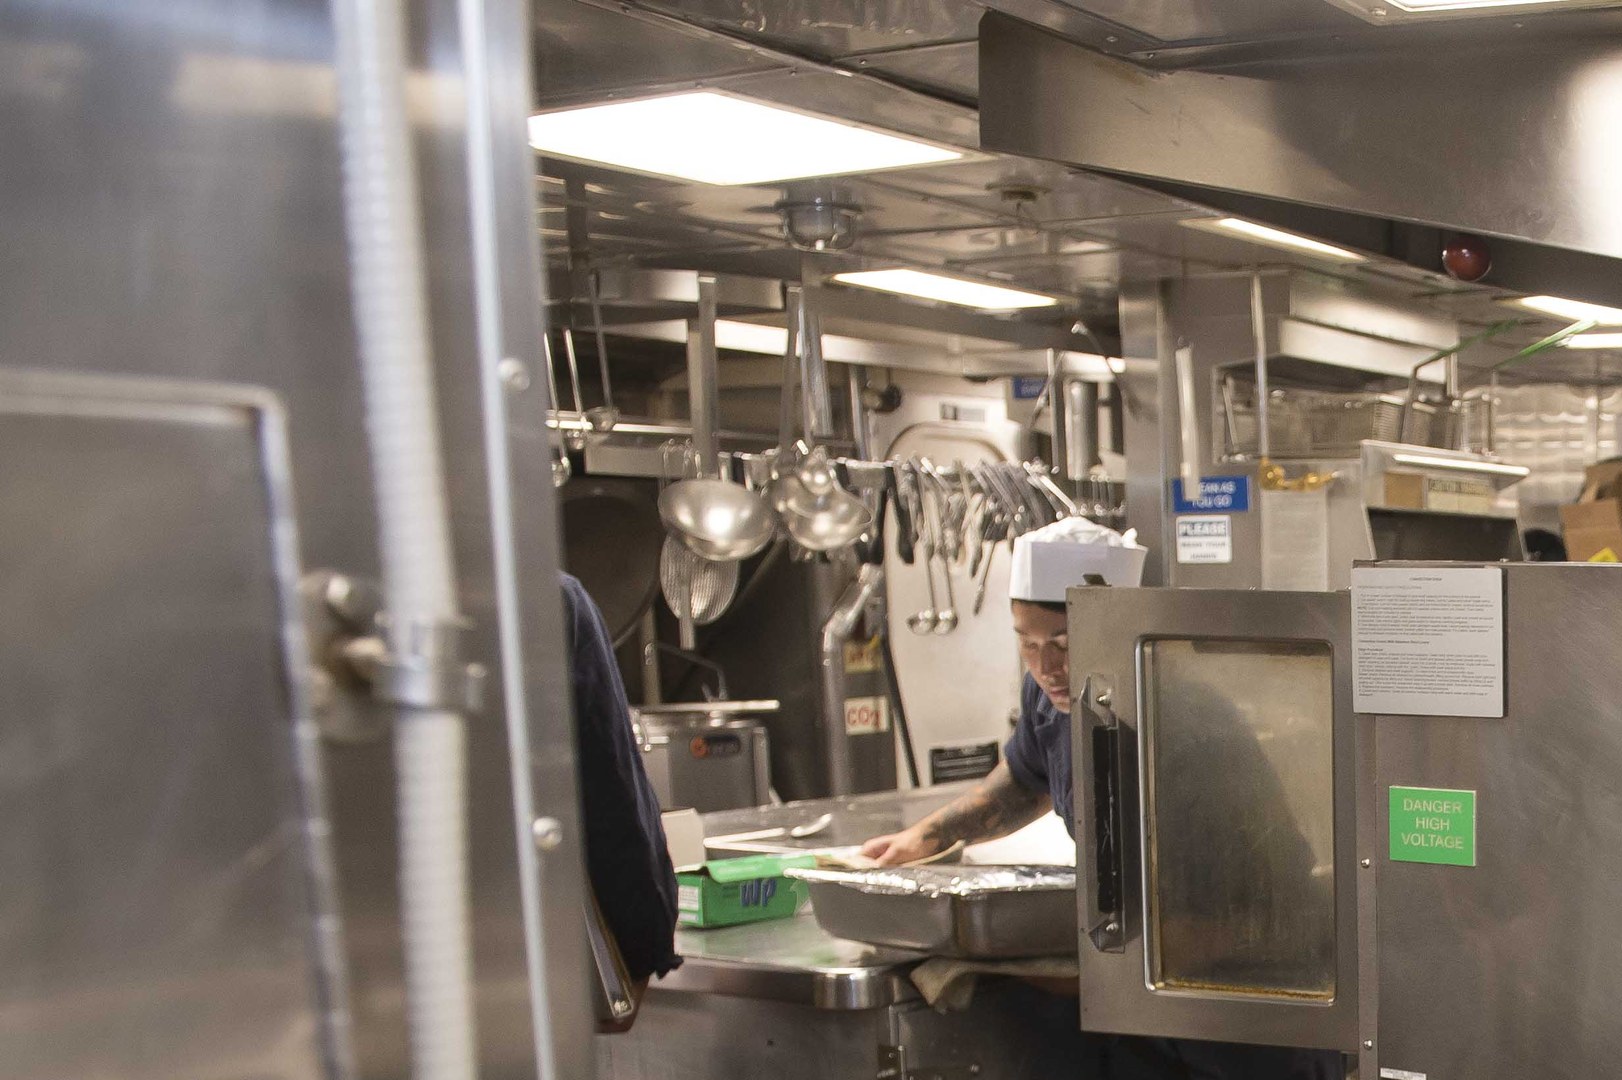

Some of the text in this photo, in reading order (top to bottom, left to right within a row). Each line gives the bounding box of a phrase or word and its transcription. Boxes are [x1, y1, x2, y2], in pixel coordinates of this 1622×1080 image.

[1178, 522, 1226, 536] PLEASE
[1403, 798, 1462, 814] DANGER
[1415, 816, 1450, 831] HIGH
[1400, 832, 1464, 849] VOLTAGE
